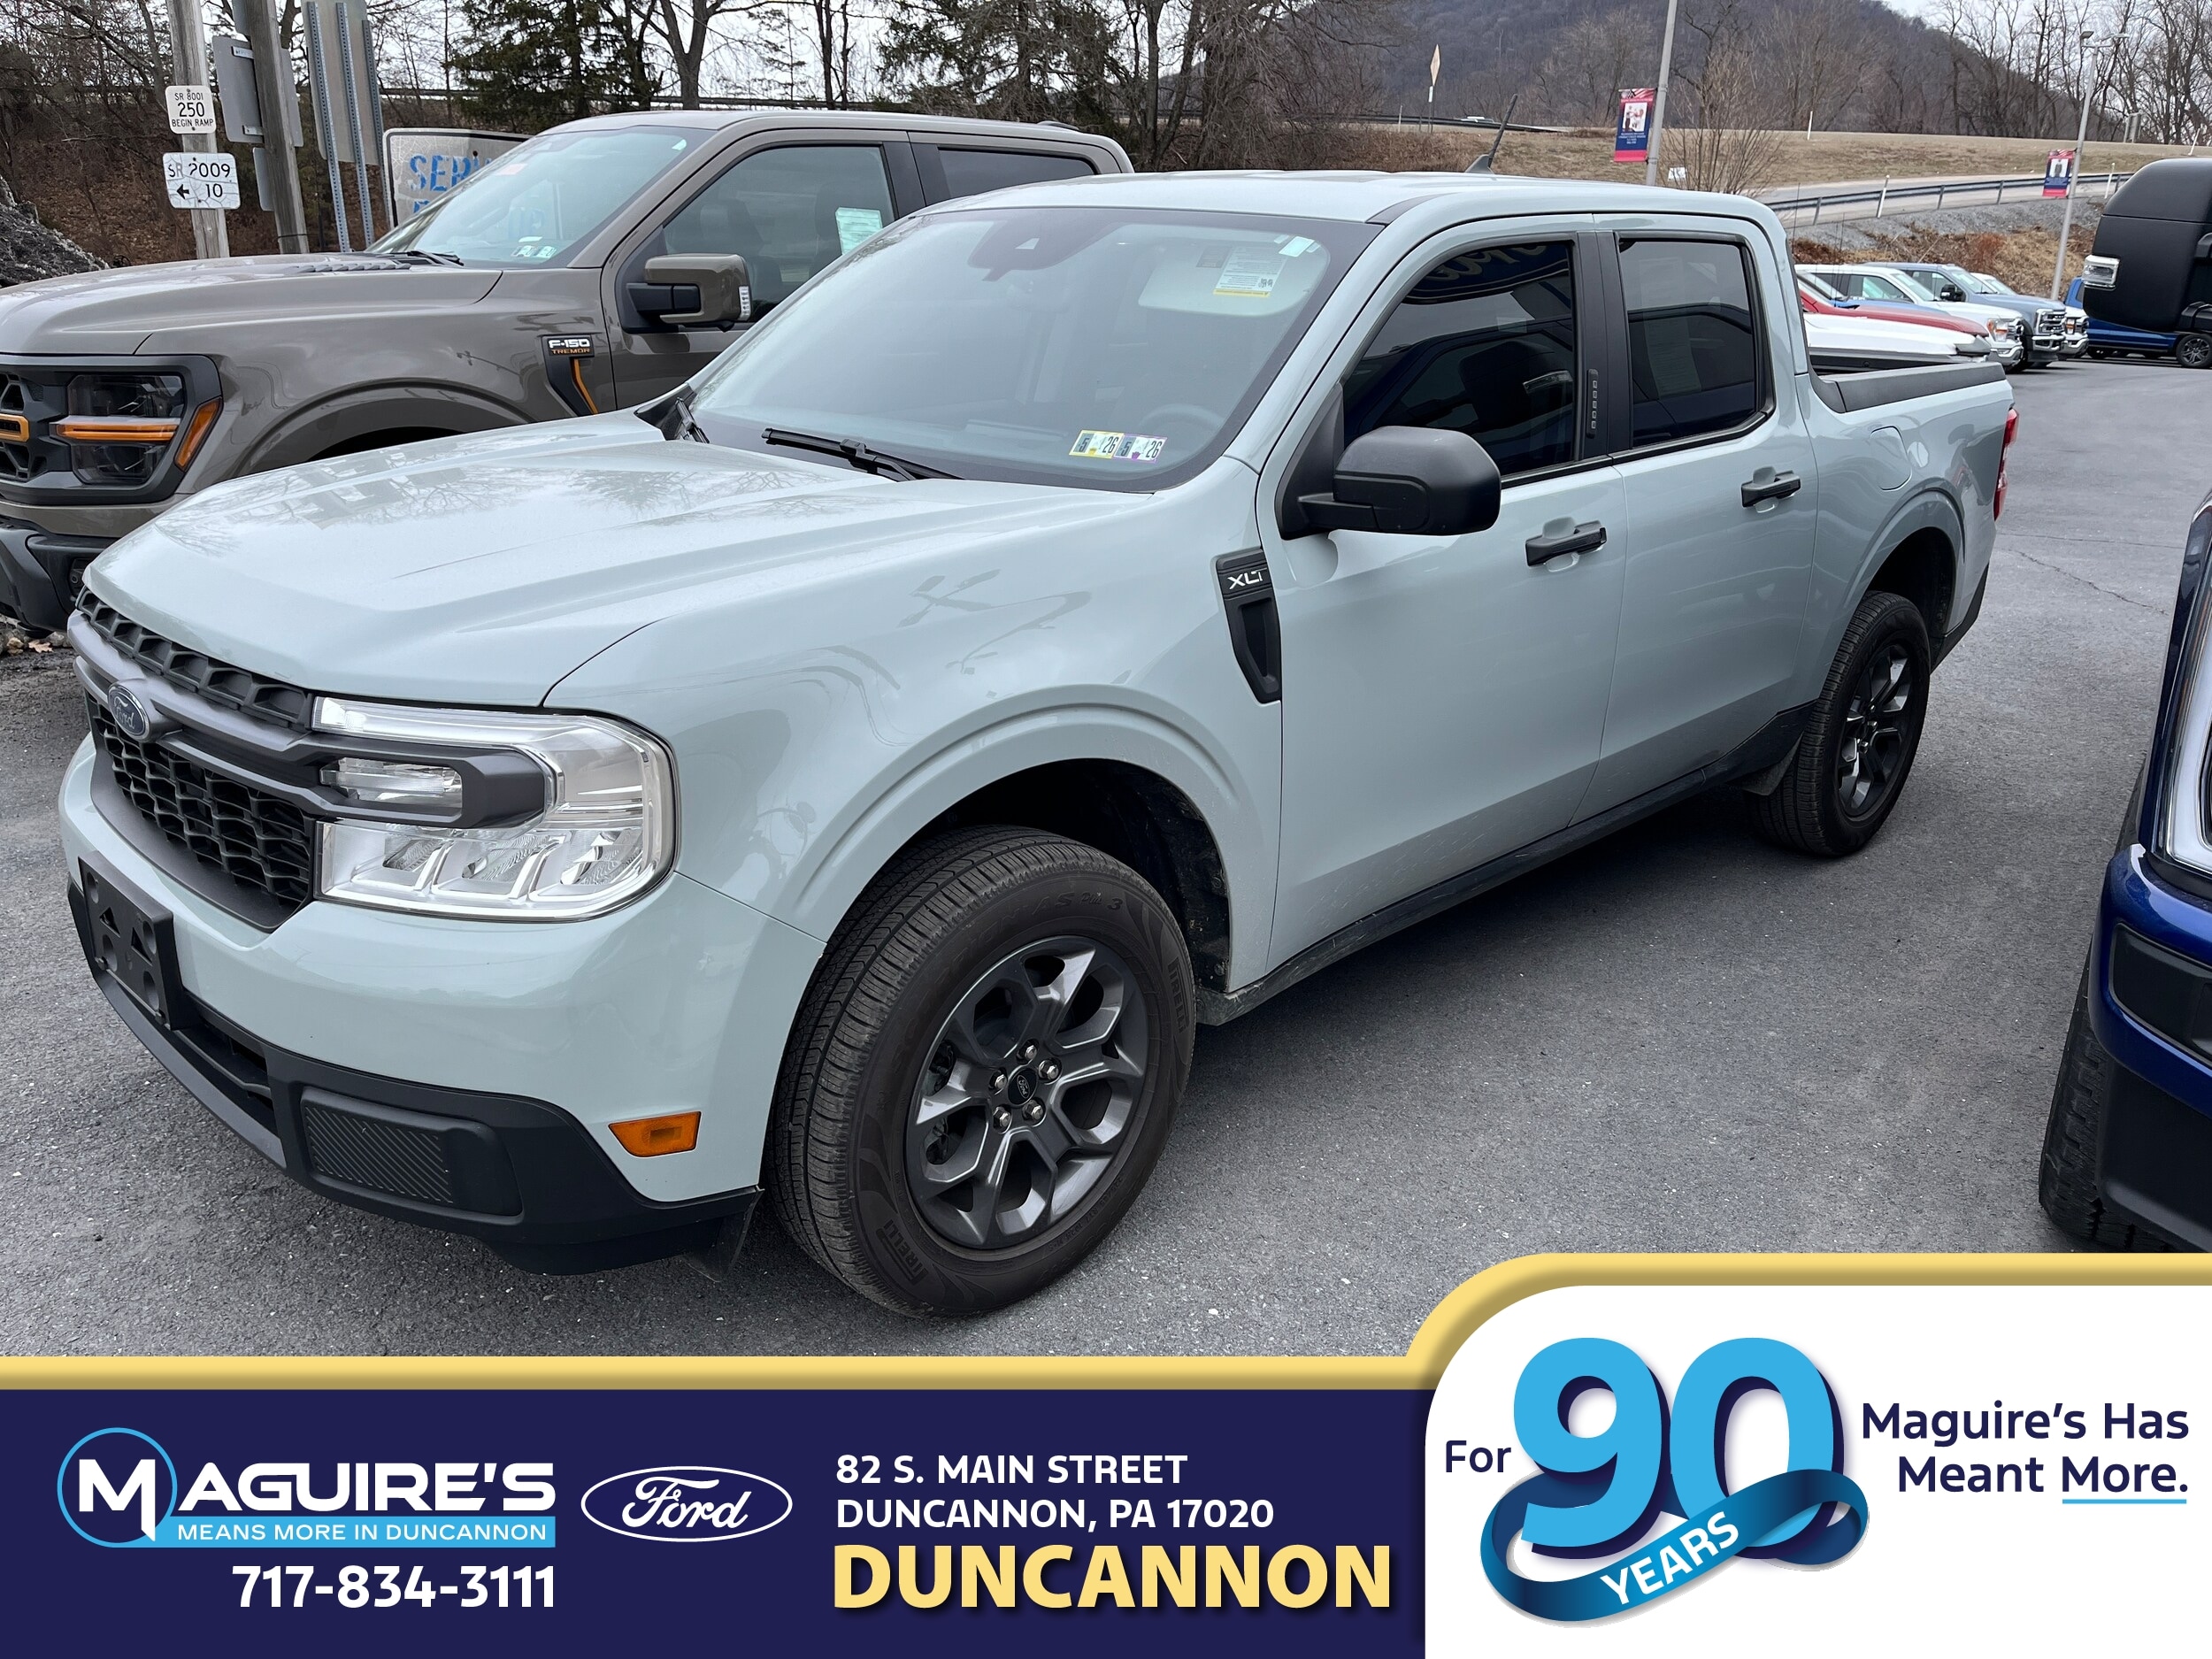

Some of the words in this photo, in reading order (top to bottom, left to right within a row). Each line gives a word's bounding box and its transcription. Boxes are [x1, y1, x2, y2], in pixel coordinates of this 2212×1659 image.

[174, 92, 185, 101] SR
[187, 92, 204, 101] 8001
[177, 102, 205, 118] 250
[171, 119, 193, 127] BEGIN
[194, 119, 214, 127] RAMP
[168, 163, 183, 178] SR
[205, 183, 223, 197] 10
[548, 338, 591, 349] F-150
[1102, 435, 1119, 454] 26
[1145, 441, 1163, 458] 26
[1226, 567, 1268, 590] XLT
[113, 695, 135, 730] Ford
[1106, 896, 1124, 910] 3
[1167, 956, 1190, 1033] PIRELLI
[875, 1218, 929, 1286] PIRELLI
